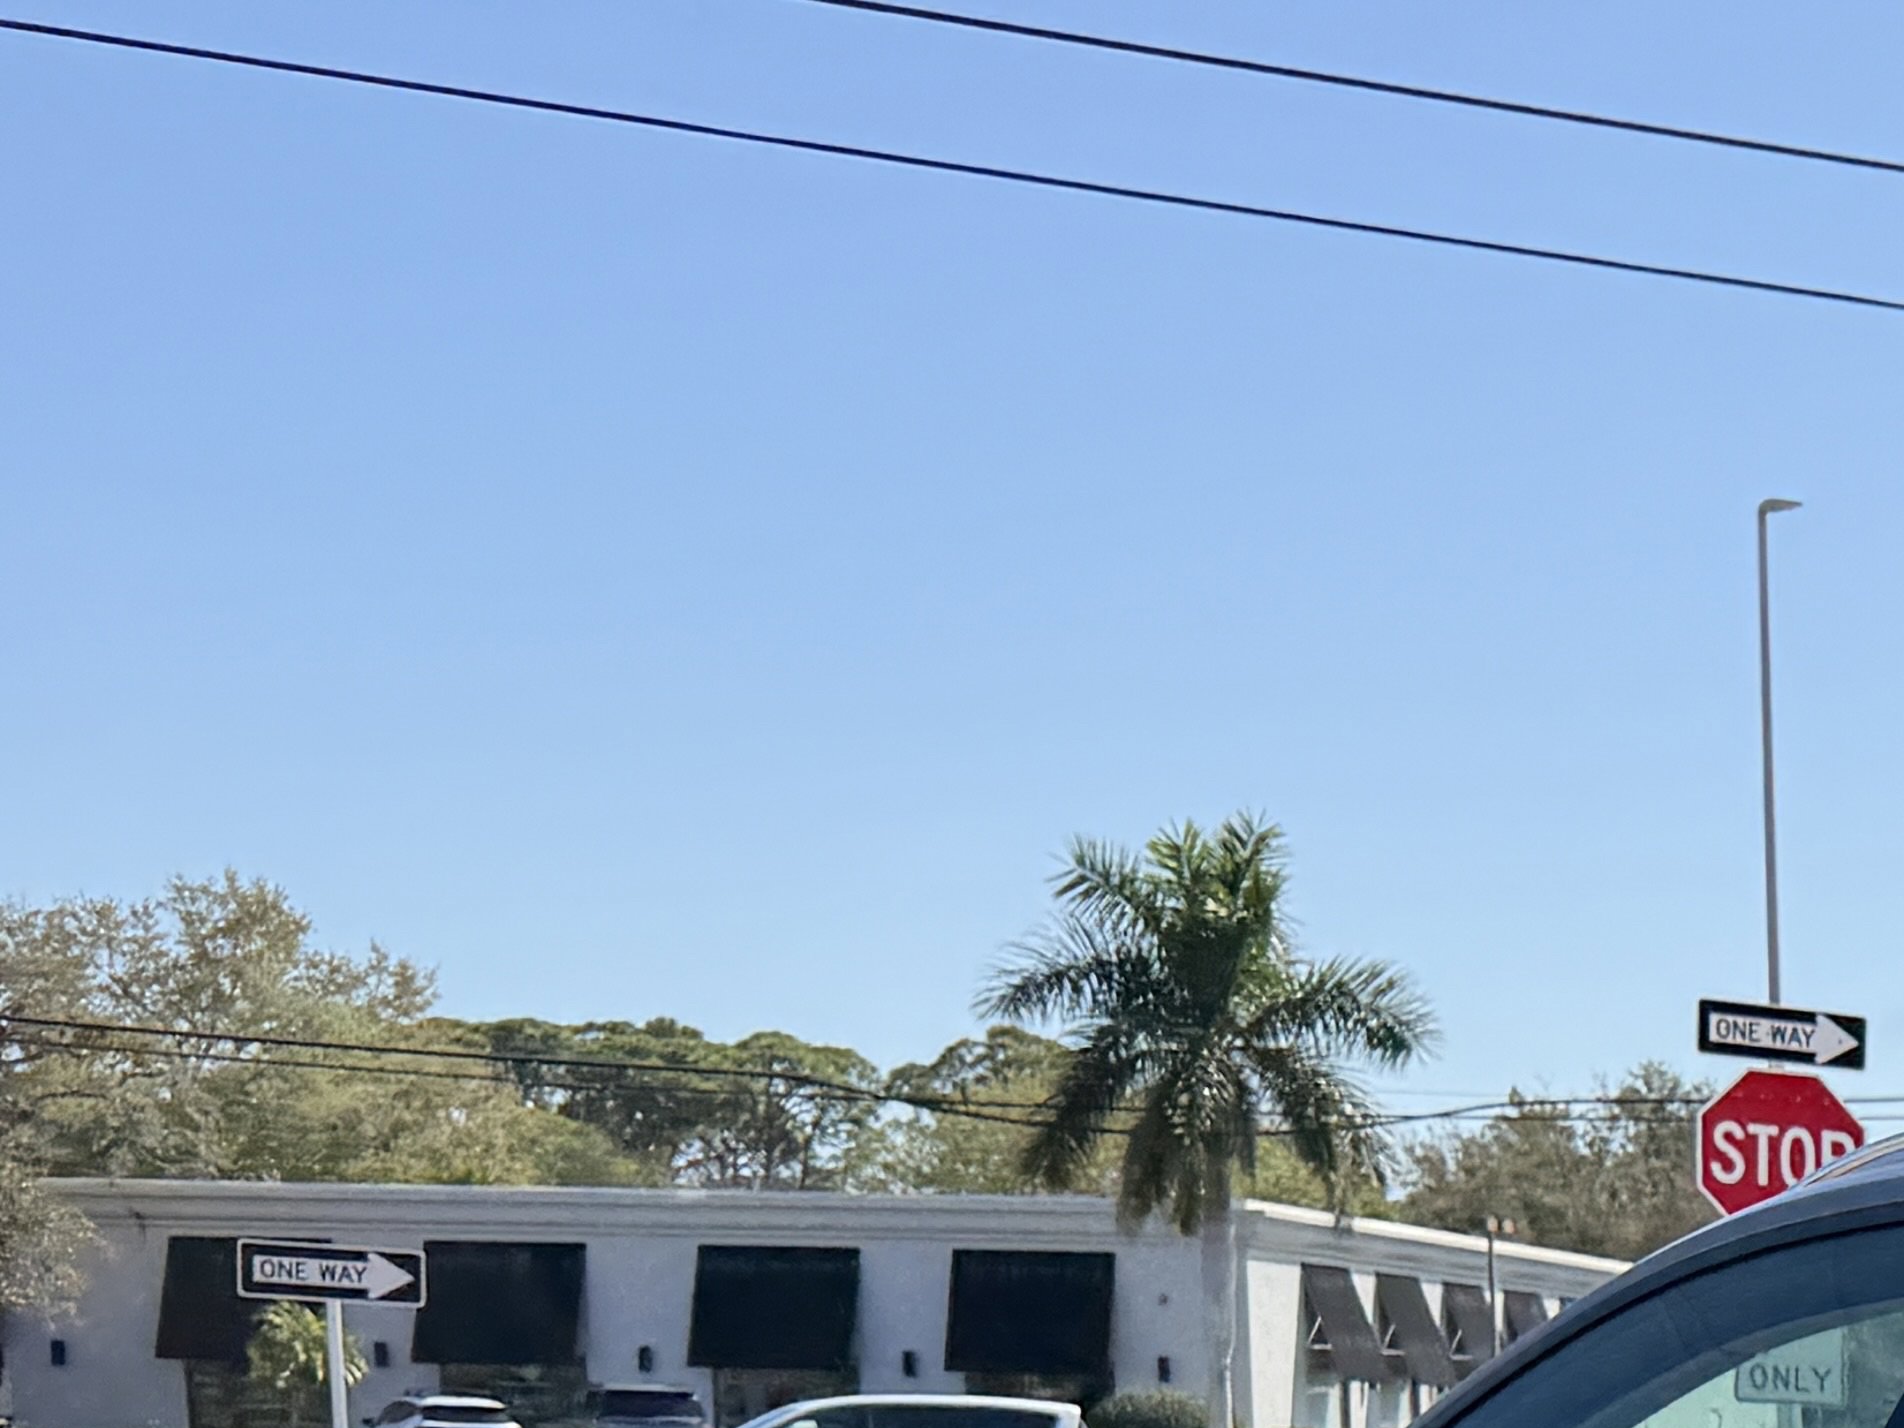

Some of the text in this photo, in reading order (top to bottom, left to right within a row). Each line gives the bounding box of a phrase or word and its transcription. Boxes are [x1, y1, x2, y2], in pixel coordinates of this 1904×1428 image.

[1716, 1018, 1816, 1048] ONE WAY
[260, 1258, 368, 1284] ONE WAY
[1750, 1362, 1831, 1394] ONLY
